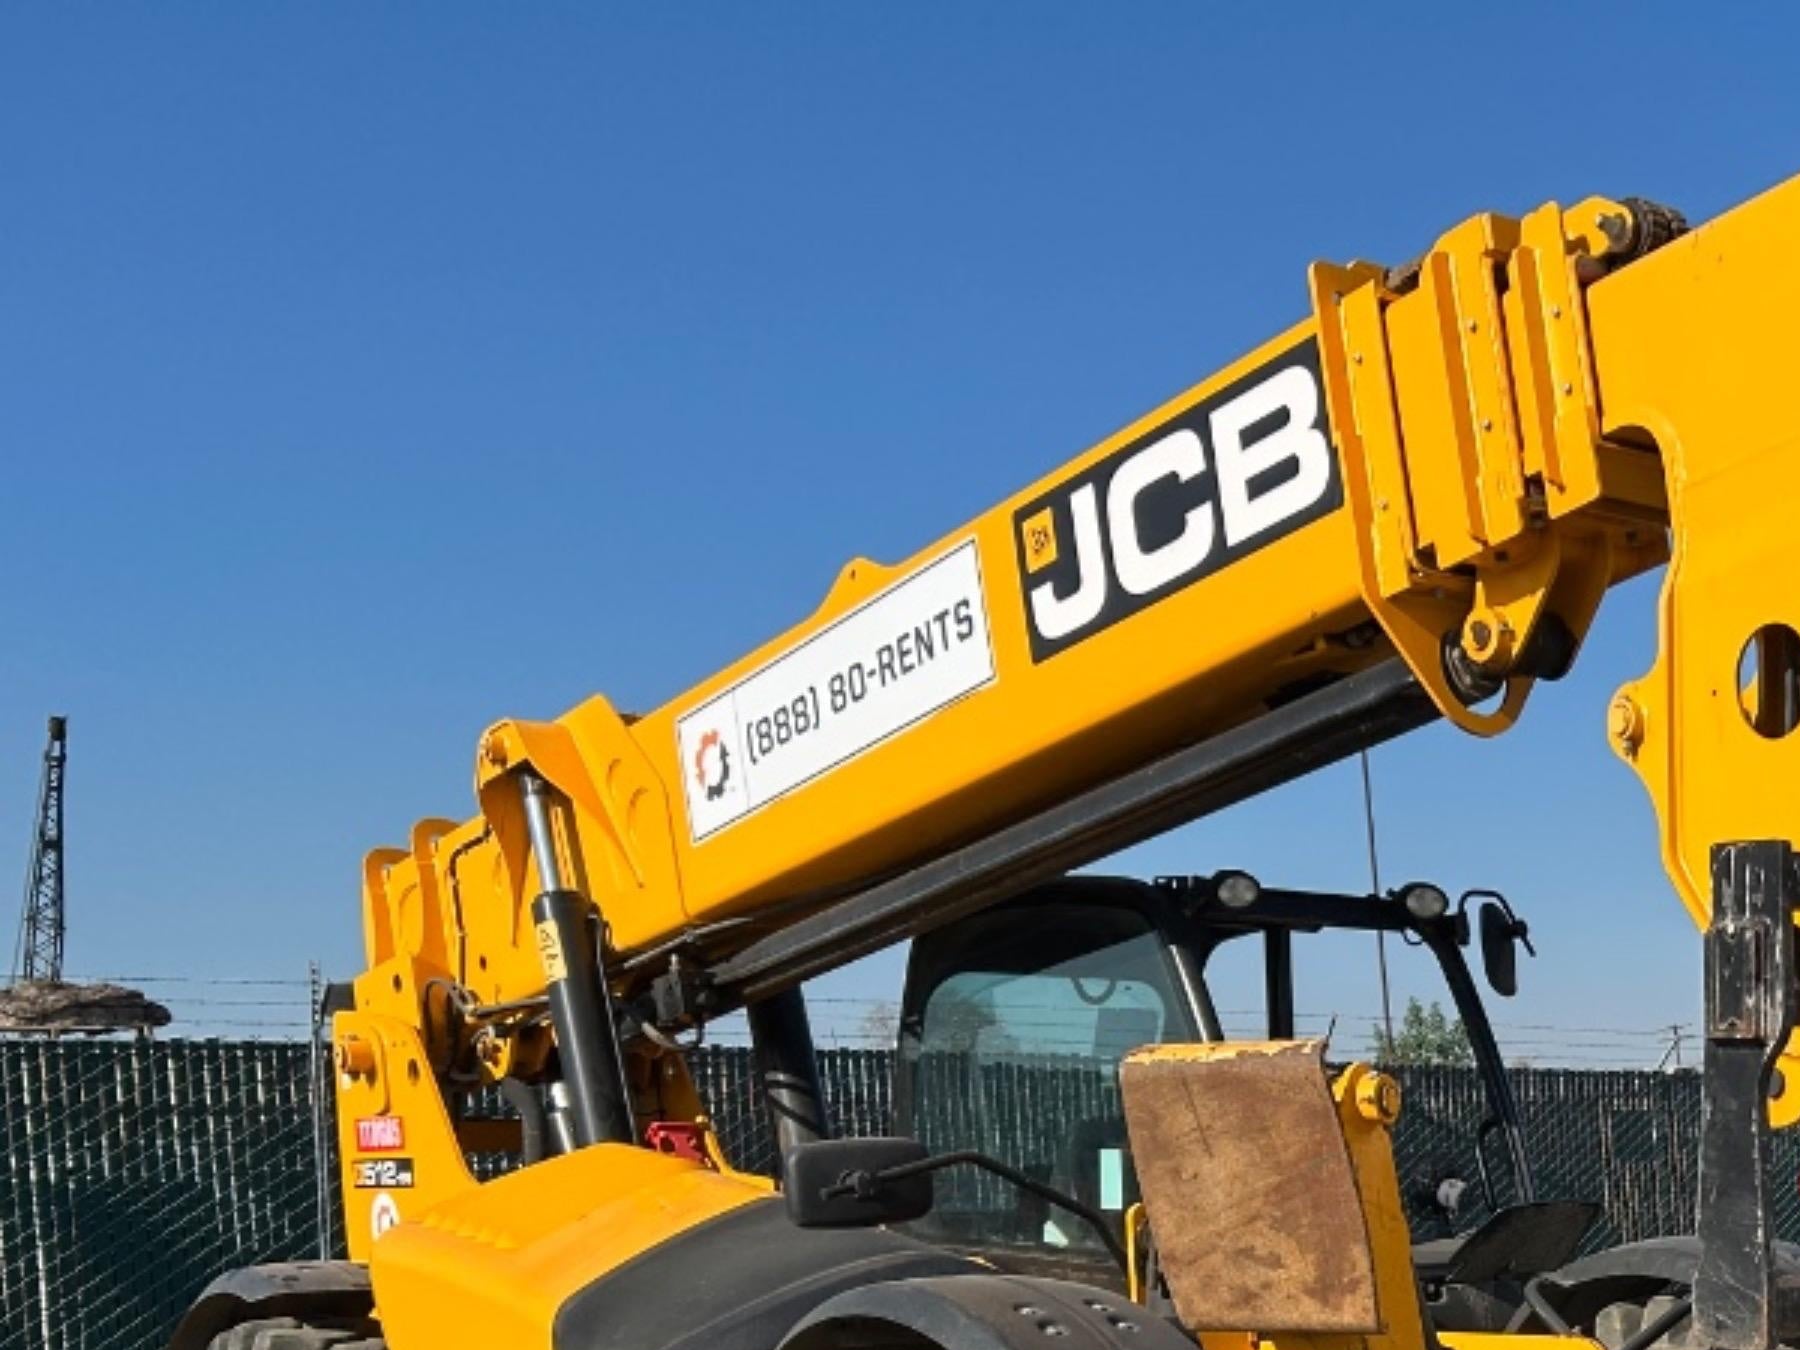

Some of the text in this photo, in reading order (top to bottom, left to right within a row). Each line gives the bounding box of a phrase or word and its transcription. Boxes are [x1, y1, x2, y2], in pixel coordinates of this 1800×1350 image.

[1031, 365, 1330, 640] JCB
[745, 597, 975, 765] (888) 80-RENTS
